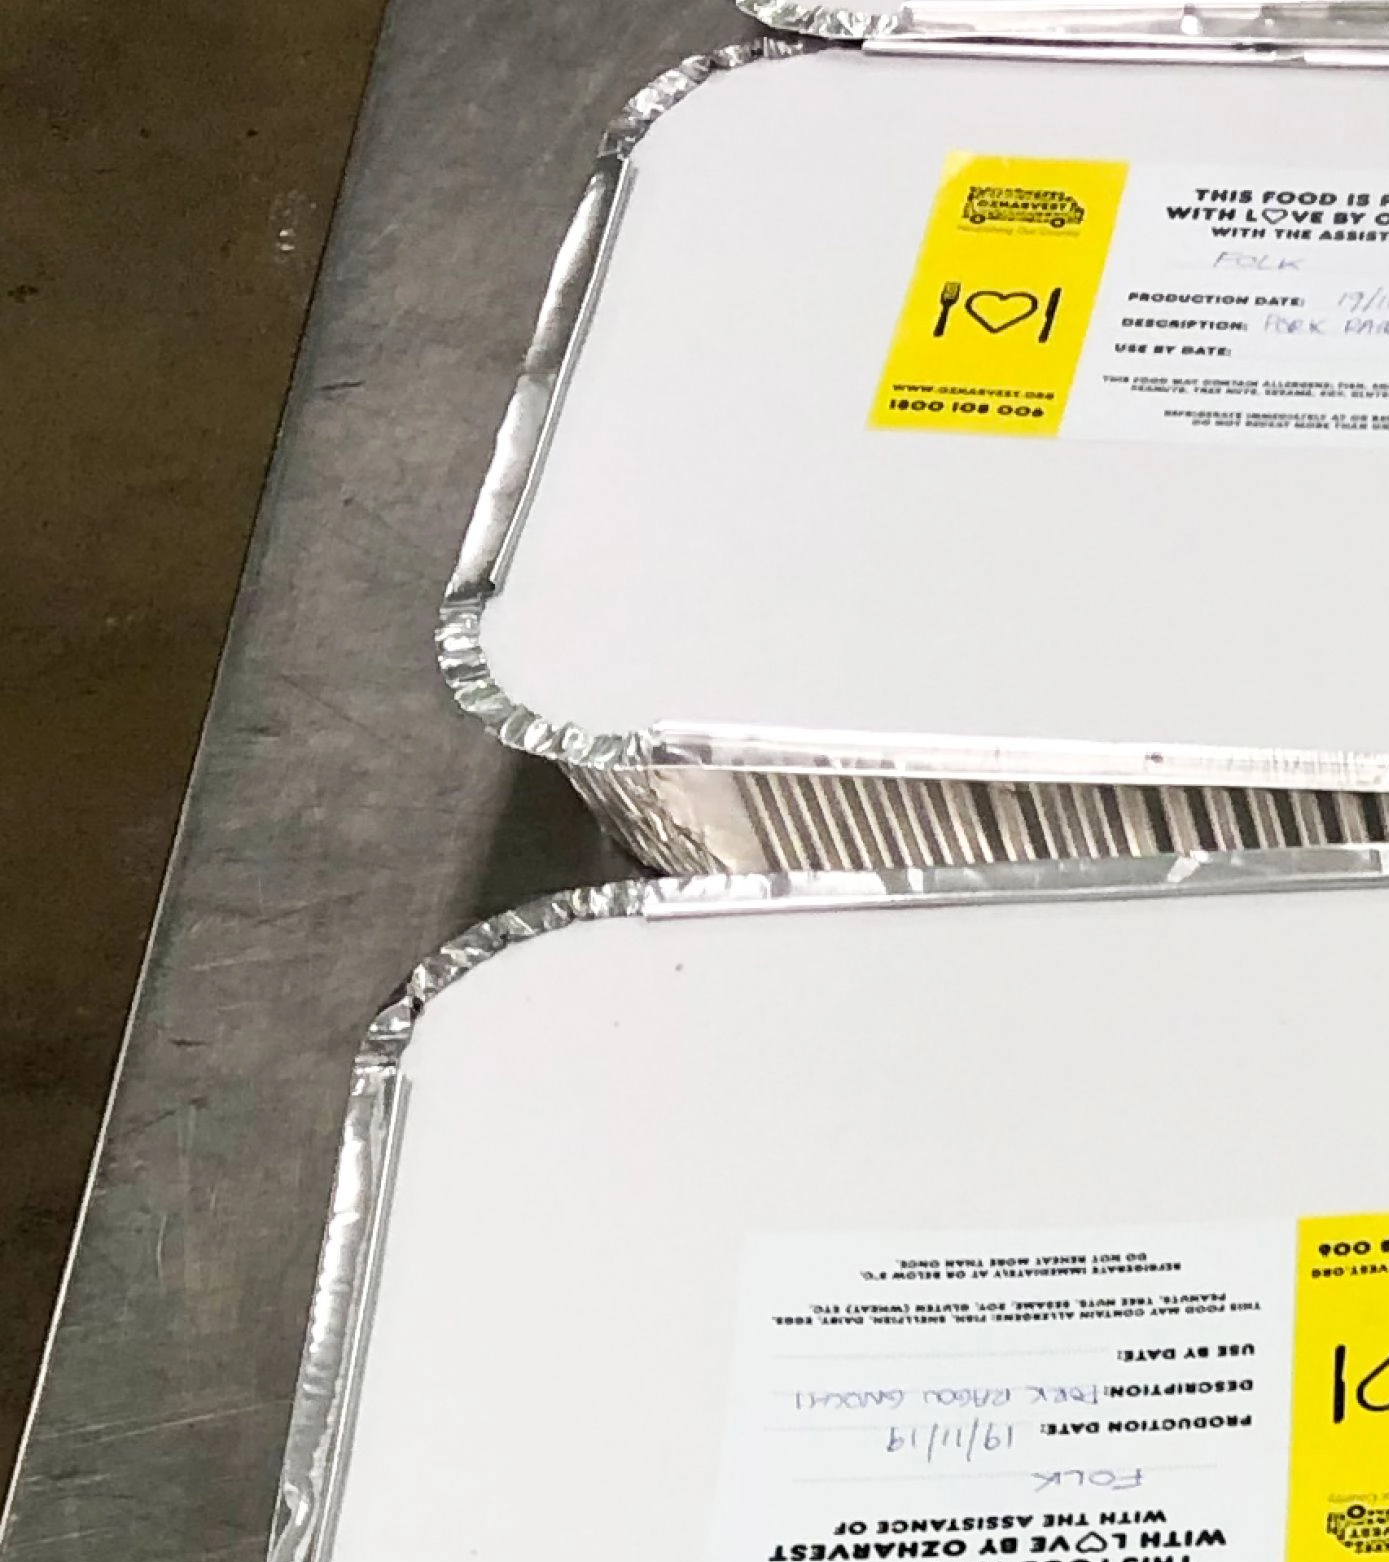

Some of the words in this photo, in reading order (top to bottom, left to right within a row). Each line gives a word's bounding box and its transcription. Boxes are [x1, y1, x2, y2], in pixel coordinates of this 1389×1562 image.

[1196, 189, 1252, 204] THIS
[1262, 191, 1337, 206] FOOD
[1347, 193, 1370, 207] IS
[1167, 206, 1236, 221] WITH
[1333, 212, 1366, 225] BY
[1212, 227, 1266, 238] WITH
[1275, 229, 1312, 240] THE
[1128, 292, 1249, 305] PRODUCTION
[1255, 297, 1304, 306] DATE:
[889, 399, 944, 412] 1800
[952, 402, 989, 414] 108
[997, 405, 1044, 417] 006
[1318, 1241, 1371, 1257] 006
[1041, 1422, 1100, 1435] DATE:
[1108, 1415, 1252, 1432] PRODUCTION
[886, 1418, 1013, 1463] 19/11/19
[1031, 1468, 1144, 1493] FOLK
[877, 1515, 1033, 1534] ASSISTANCE
[1043, 1513, 1089, 1527] THE
[1100, 1510, 1166, 1525] WITH
[834, 1521, 867, 1535] OF
[979, 1537, 1018, 1555] BY
[1140, 1529, 1226, 1548] WITH
[769, 1539, 967, 1562] OZHARVEST
